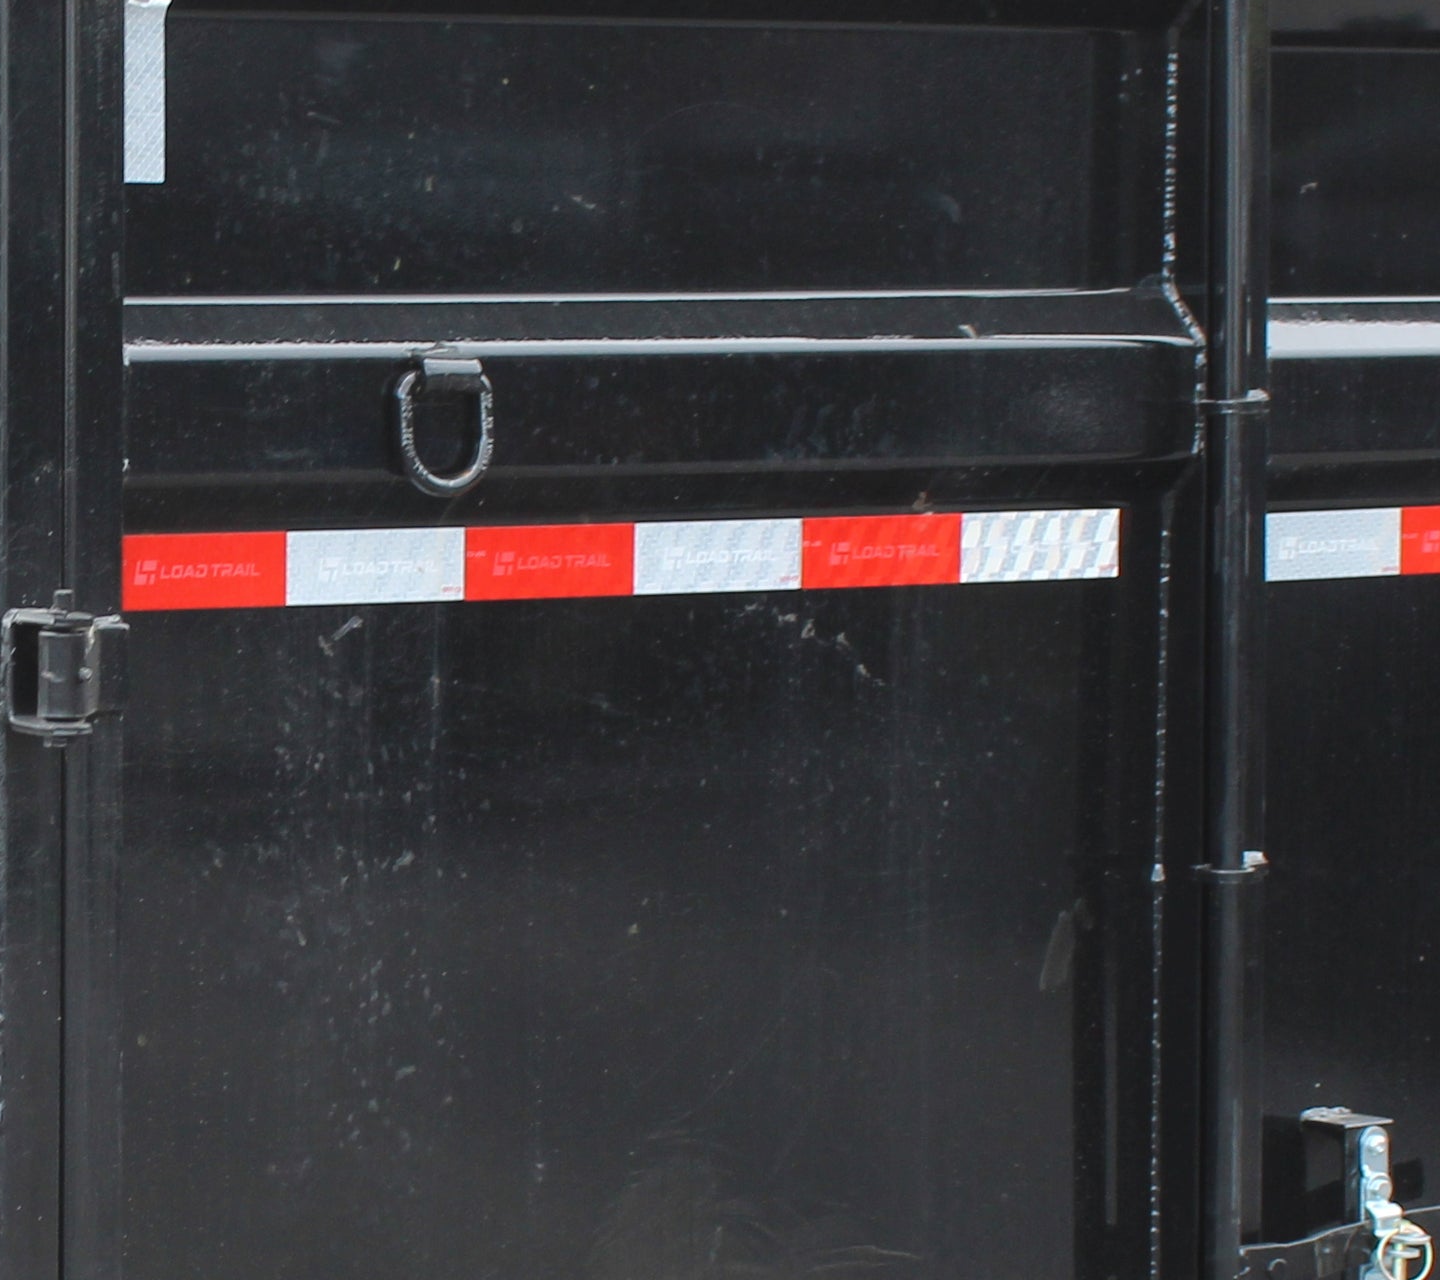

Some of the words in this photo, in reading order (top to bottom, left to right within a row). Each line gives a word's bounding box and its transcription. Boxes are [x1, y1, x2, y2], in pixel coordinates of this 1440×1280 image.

[686, 550, 730, 564] LOAD
[731, 548, 775, 562] TRAIL
[852, 545, 895, 560] LOAD
[896, 544, 940, 559] TRAIL
[340, 561, 389, 575] LOAD
[517, 555, 563, 570] LOAD
[564, 553, 611, 568] TRAIL
[160, 564, 209, 580] LOAD
[212, 562, 260, 578] TRAIL
